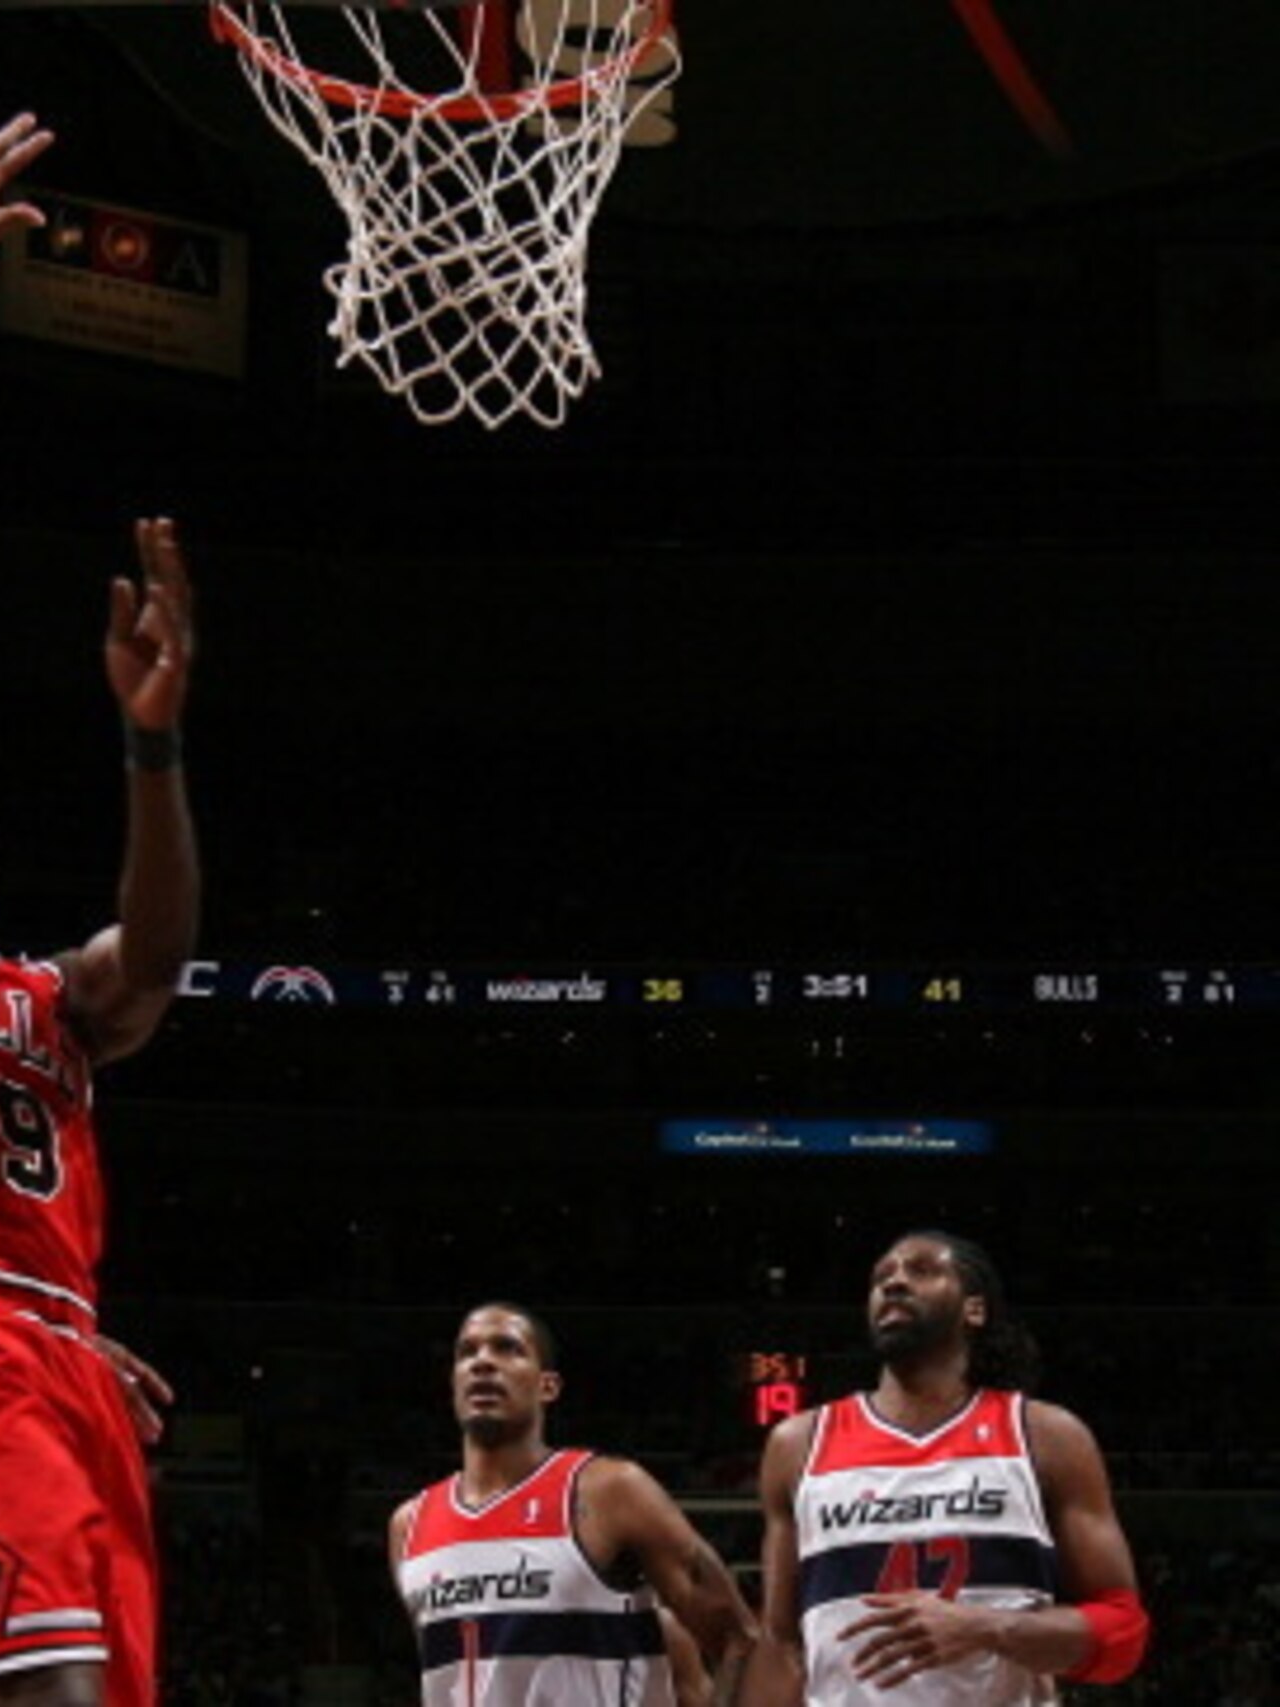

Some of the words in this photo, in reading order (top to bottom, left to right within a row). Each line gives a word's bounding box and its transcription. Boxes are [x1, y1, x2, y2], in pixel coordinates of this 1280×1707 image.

[486, 969, 609, 1002] wizards
[801, 973, 870, 999] 3:51
[819, 1476, 1010, 1531] wizards
